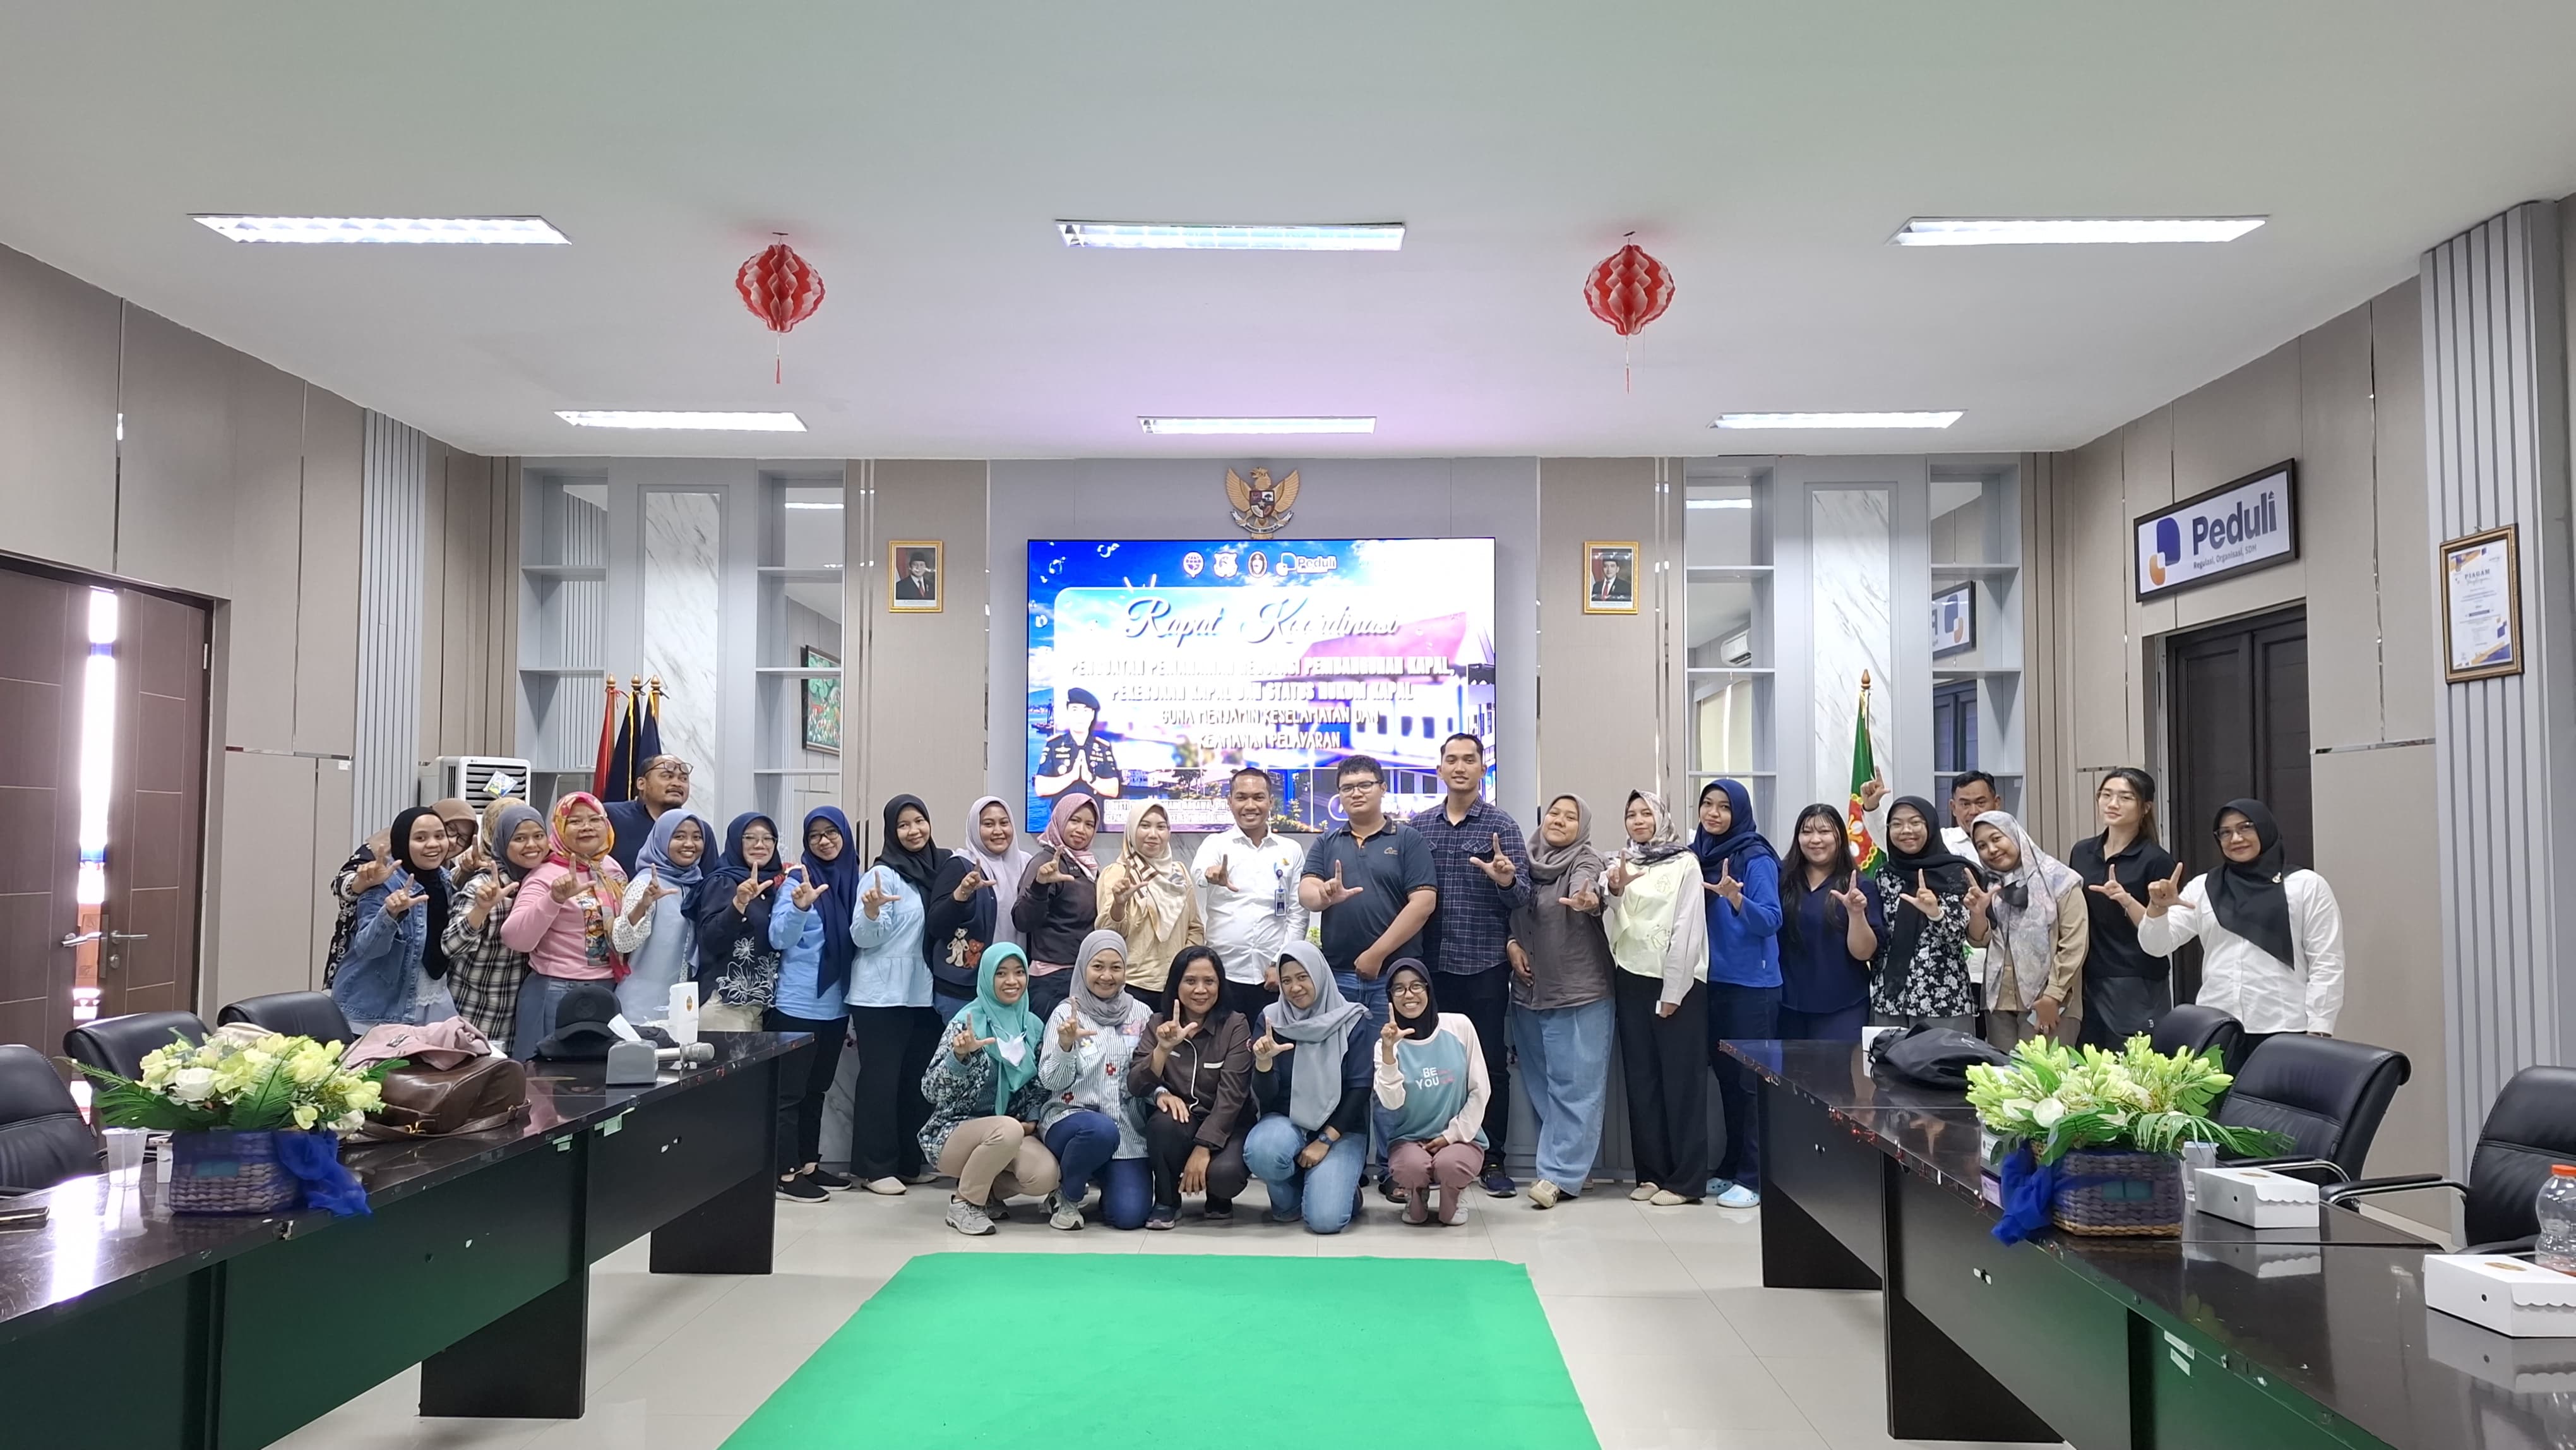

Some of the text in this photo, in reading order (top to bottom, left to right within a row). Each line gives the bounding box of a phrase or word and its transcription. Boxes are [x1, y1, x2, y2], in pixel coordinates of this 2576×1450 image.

[2192, 490, 2277, 556] Peduli
[2193, 556, 2215, 570] Regulasi,
[2245, 544, 2257, 554] SDM
[2464, 568, 2490, 580] PIAGAM
[1126, 596, 1225, 648] Rapat
[1263, 707, 1352, 726] KESELAMATAN
[1268, 731, 1342, 750] PELAYARAN
[1422, 1067, 1438, 1079] BE
[1415, 1076, 1440, 1090] YOU
